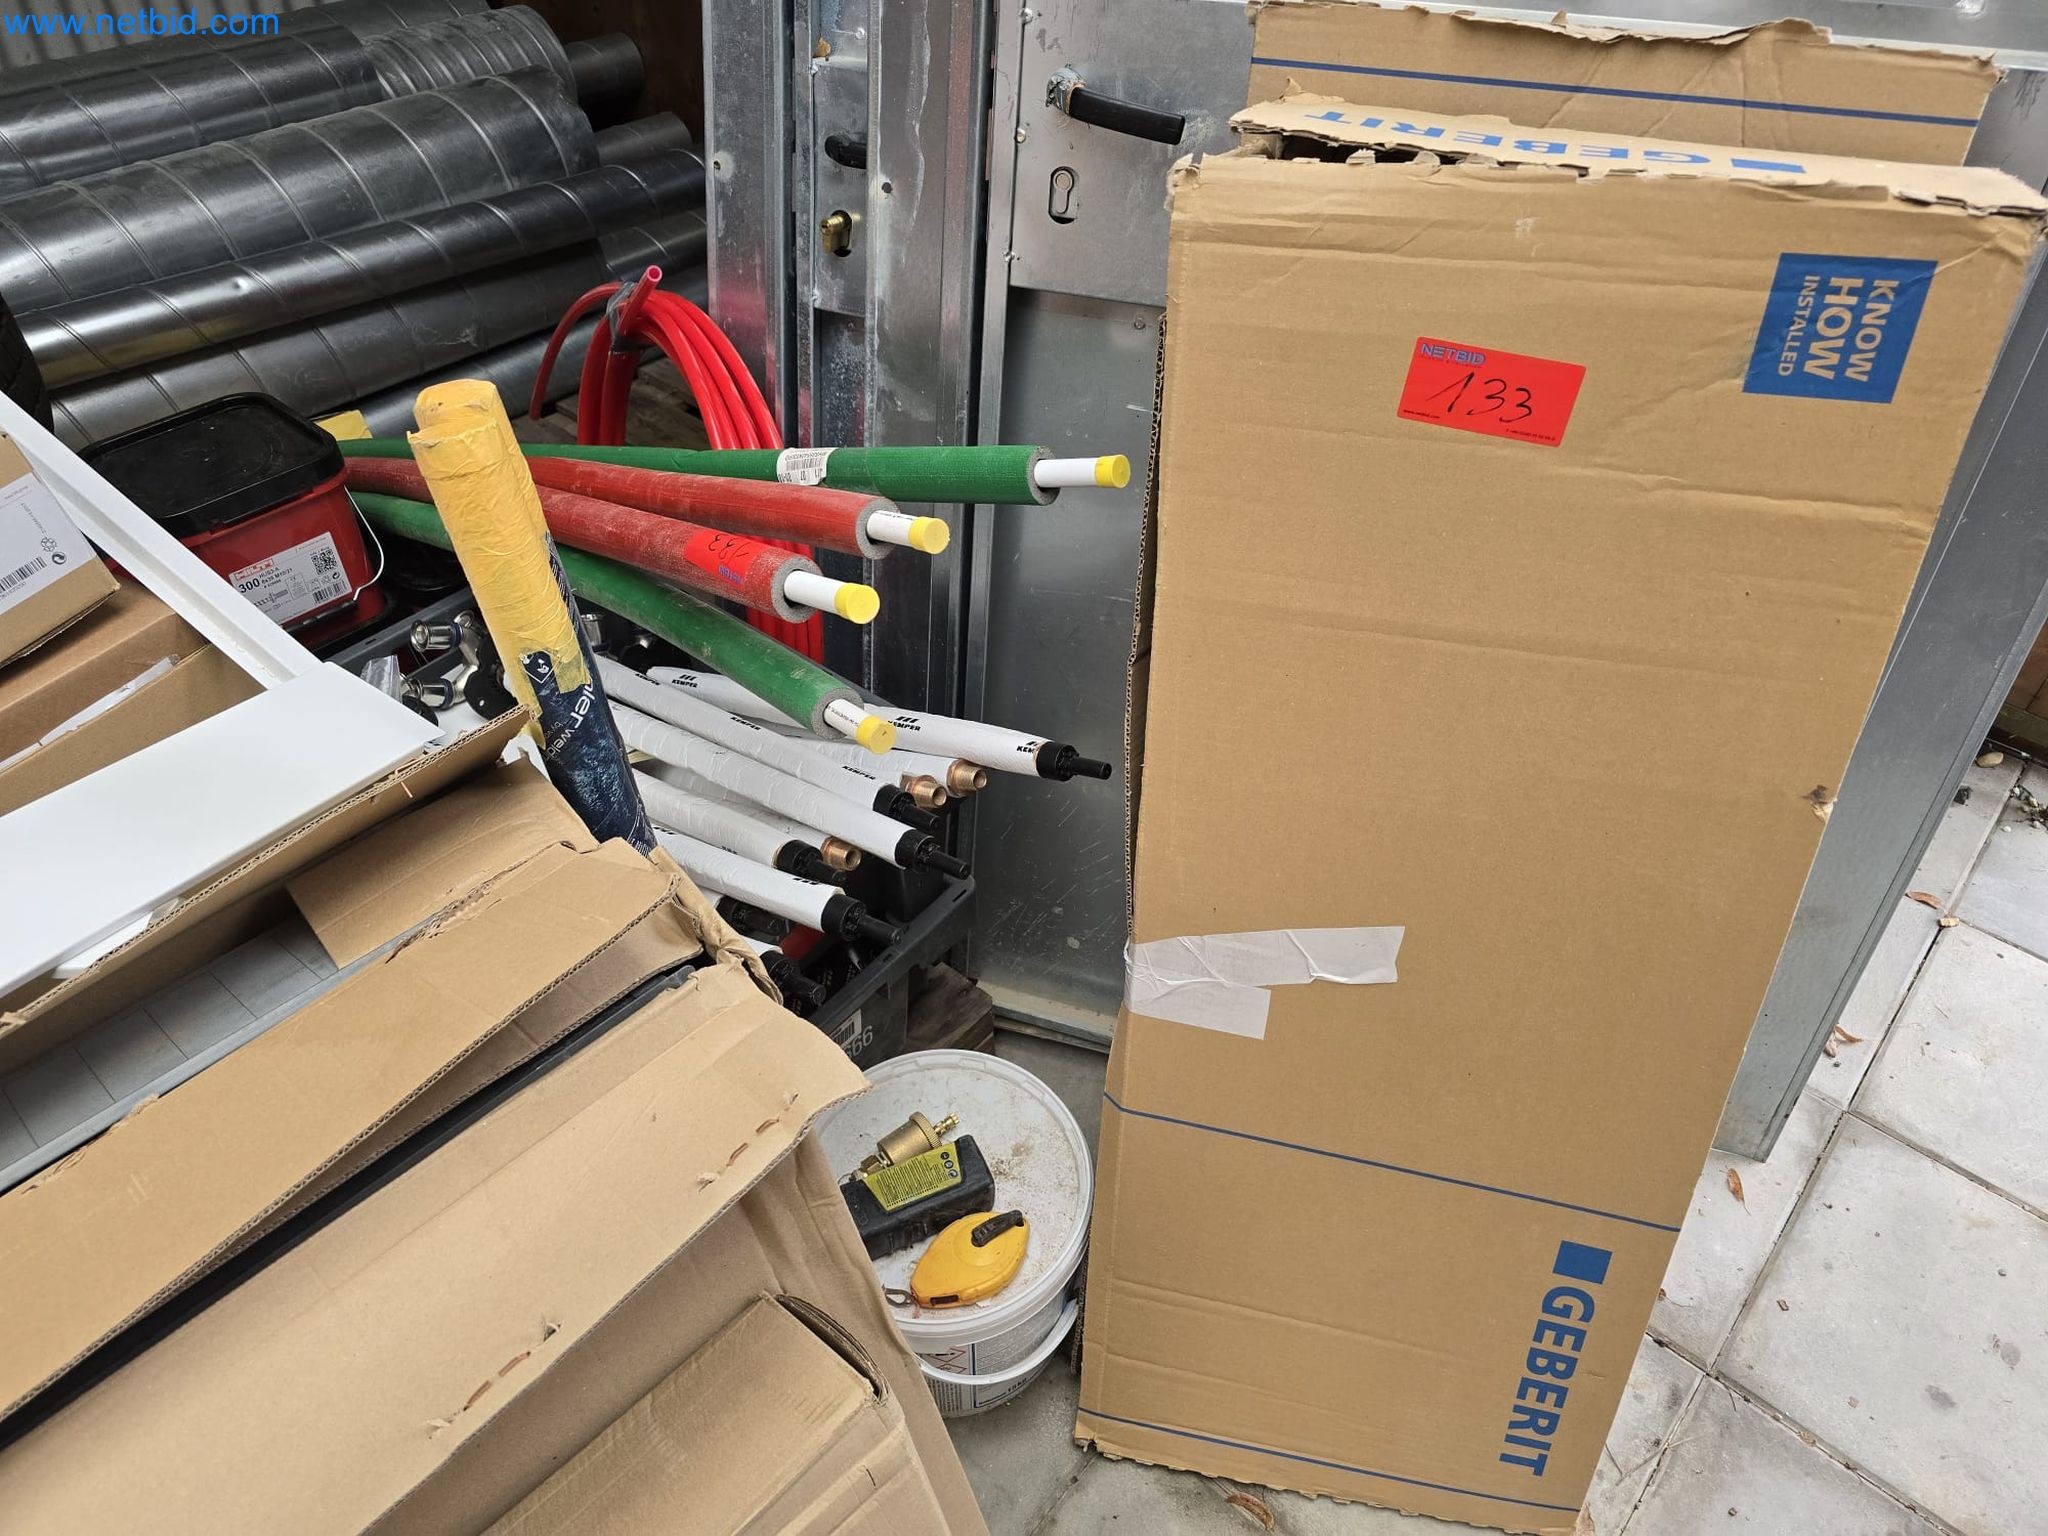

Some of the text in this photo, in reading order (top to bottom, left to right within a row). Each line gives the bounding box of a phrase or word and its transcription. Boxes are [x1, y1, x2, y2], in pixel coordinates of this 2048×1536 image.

[1303, 111, 1711, 164] GEBERIT
[1778, 275, 1820, 376] INSTALLED
[1803, 277, 1864, 380] HOW
[1844, 280, 1899, 382] KNOW
[1421, 343, 1485, 365] NETBID
[1425, 372, 1532, 423] 133
[238, 578, 261, 593] 300
[671, 679, 699, 689] KEMPER
[888, 720, 922, 731] EMPER
[1499, 1286, 1595, 1477] GEBERIT
